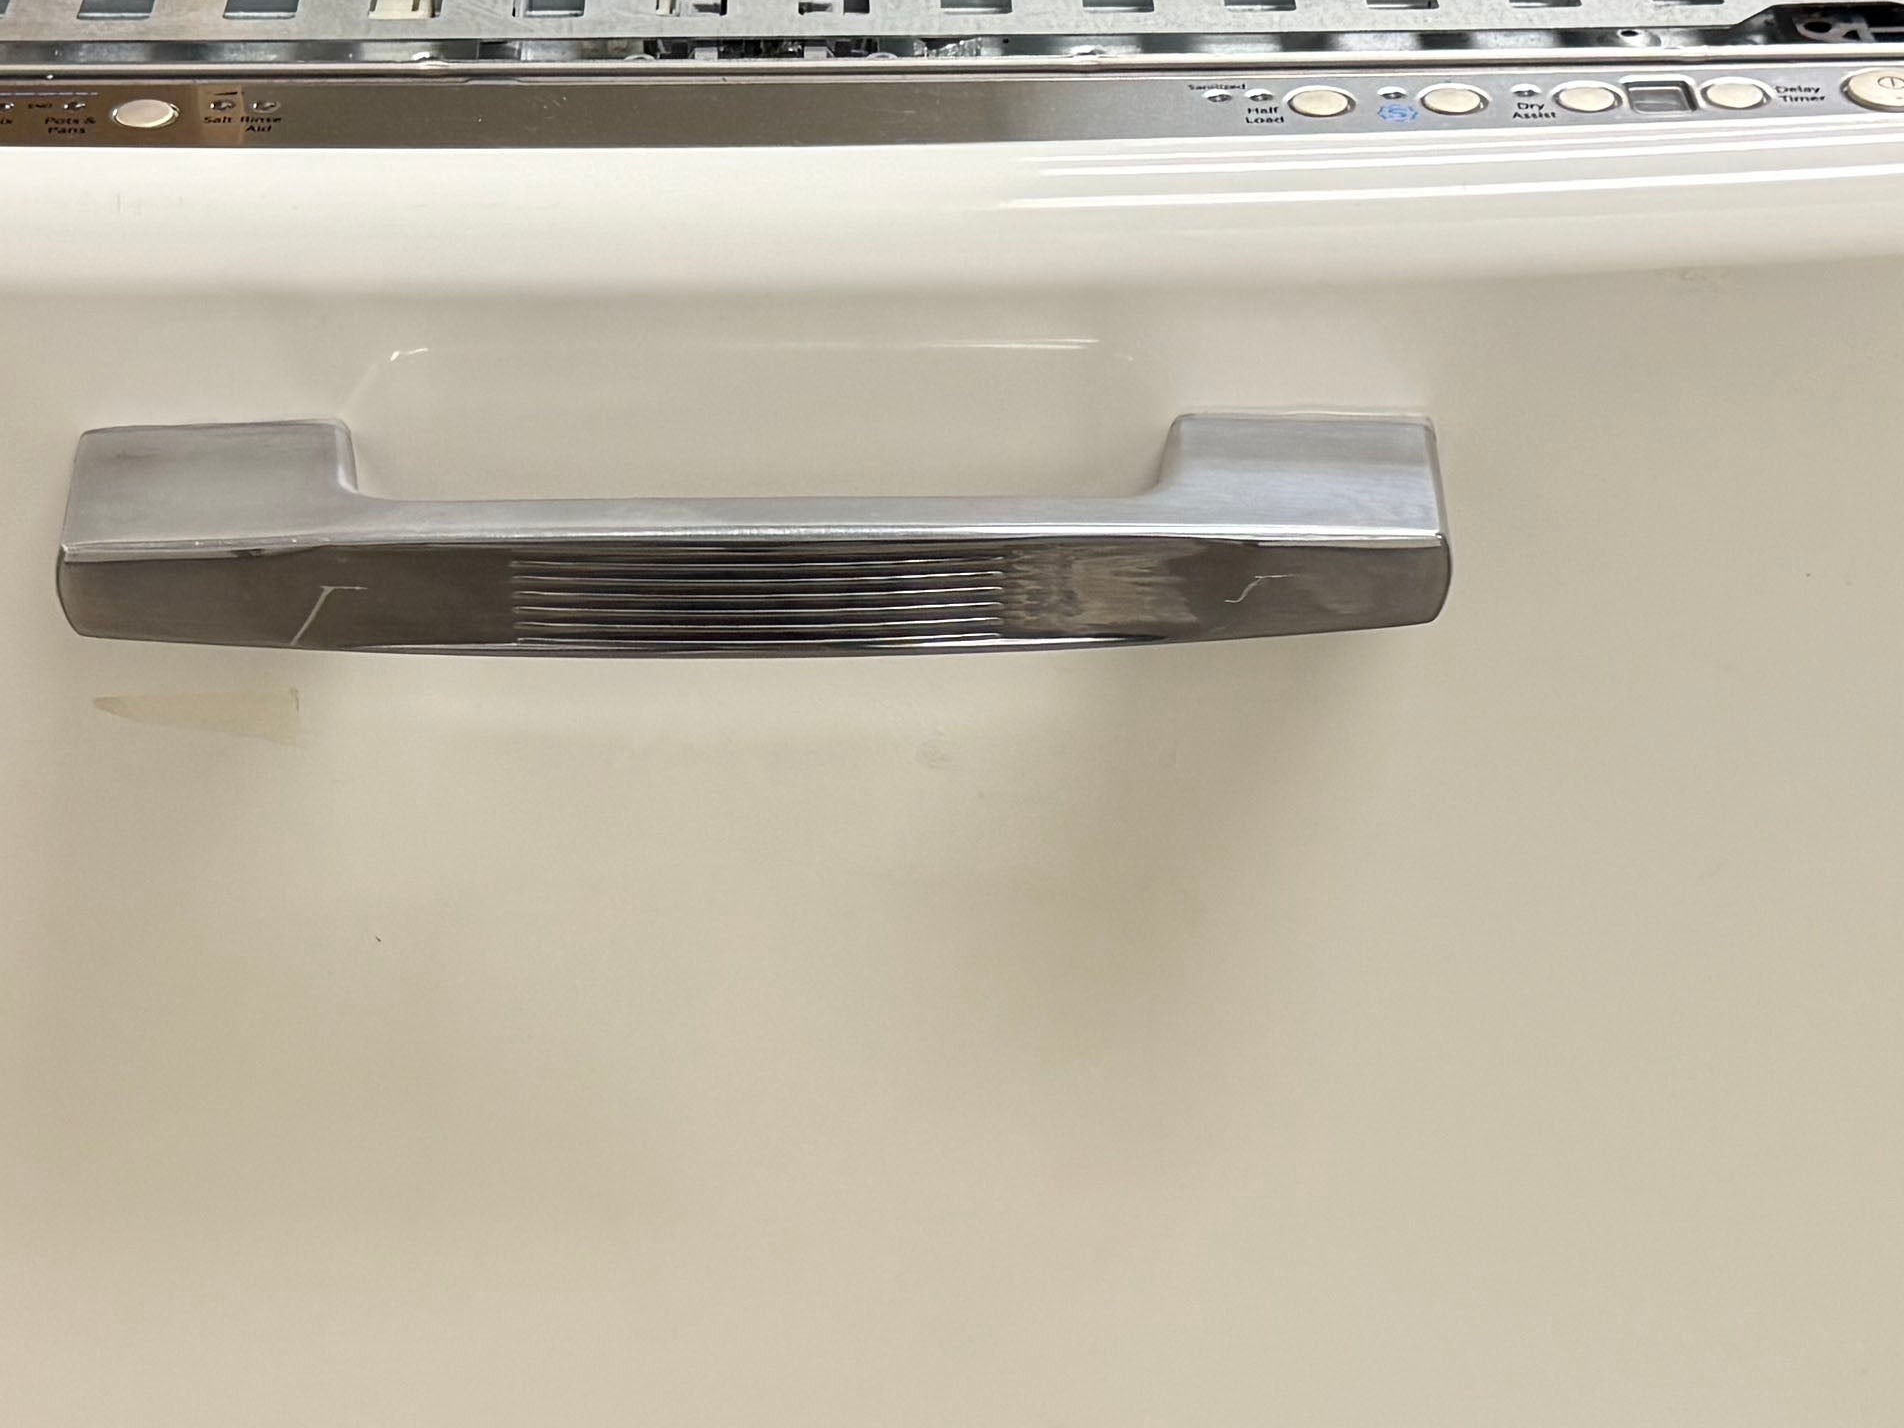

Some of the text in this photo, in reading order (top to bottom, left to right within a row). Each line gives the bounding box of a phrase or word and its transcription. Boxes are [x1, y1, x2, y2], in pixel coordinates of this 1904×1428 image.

[1775, 85, 1820, 95] Delay
[1780, 94, 1826, 103] Timer
[1517, 102, 1545, 111] Dry
[1247, 107, 1279, 115] Half
[1512, 111, 1557, 119] Assist
[45, 117, 80, 125] Pots
[203, 116, 233, 124] Salt
[240, 116, 282, 124] Rinse
[1245, 116, 1285, 124] Load
[245, 124, 273, 132] Aid
